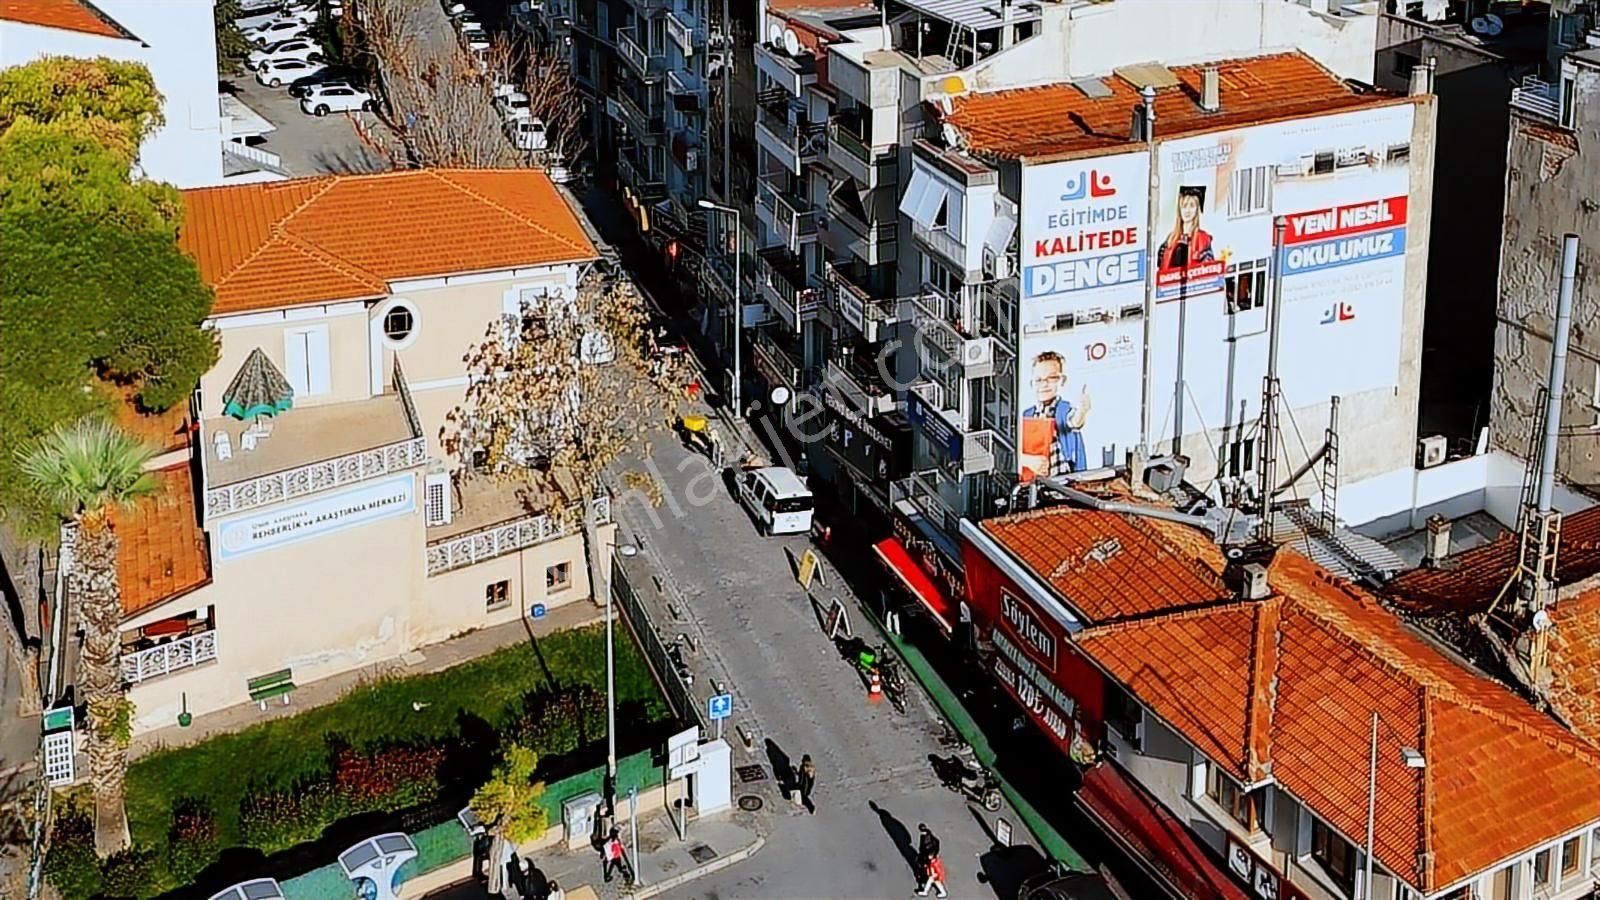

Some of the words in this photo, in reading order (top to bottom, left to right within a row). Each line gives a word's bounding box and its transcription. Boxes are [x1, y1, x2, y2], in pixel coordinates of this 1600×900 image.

[1048, 205, 1128, 229] EĞİTİMDE
[1292, 207, 1338, 237] YENİ
[1340, 199, 1393, 229] NESİL
[1035, 227, 1138, 258] KALİTEDE
[1287, 232, 1394, 270] OKULUMUZ
[1031, 252, 1140, 296] DENGE
[1085, 342, 1107, 362] 10
[251, 519, 302, 540] REHBERLİK
[303, 519, 314, 527] ve
[314, 503, 367, 524] ARAŞTIRMA
[367, 493, 407, 510] MERKEZİ
[1003, 594, 1051, 659] Söylem
